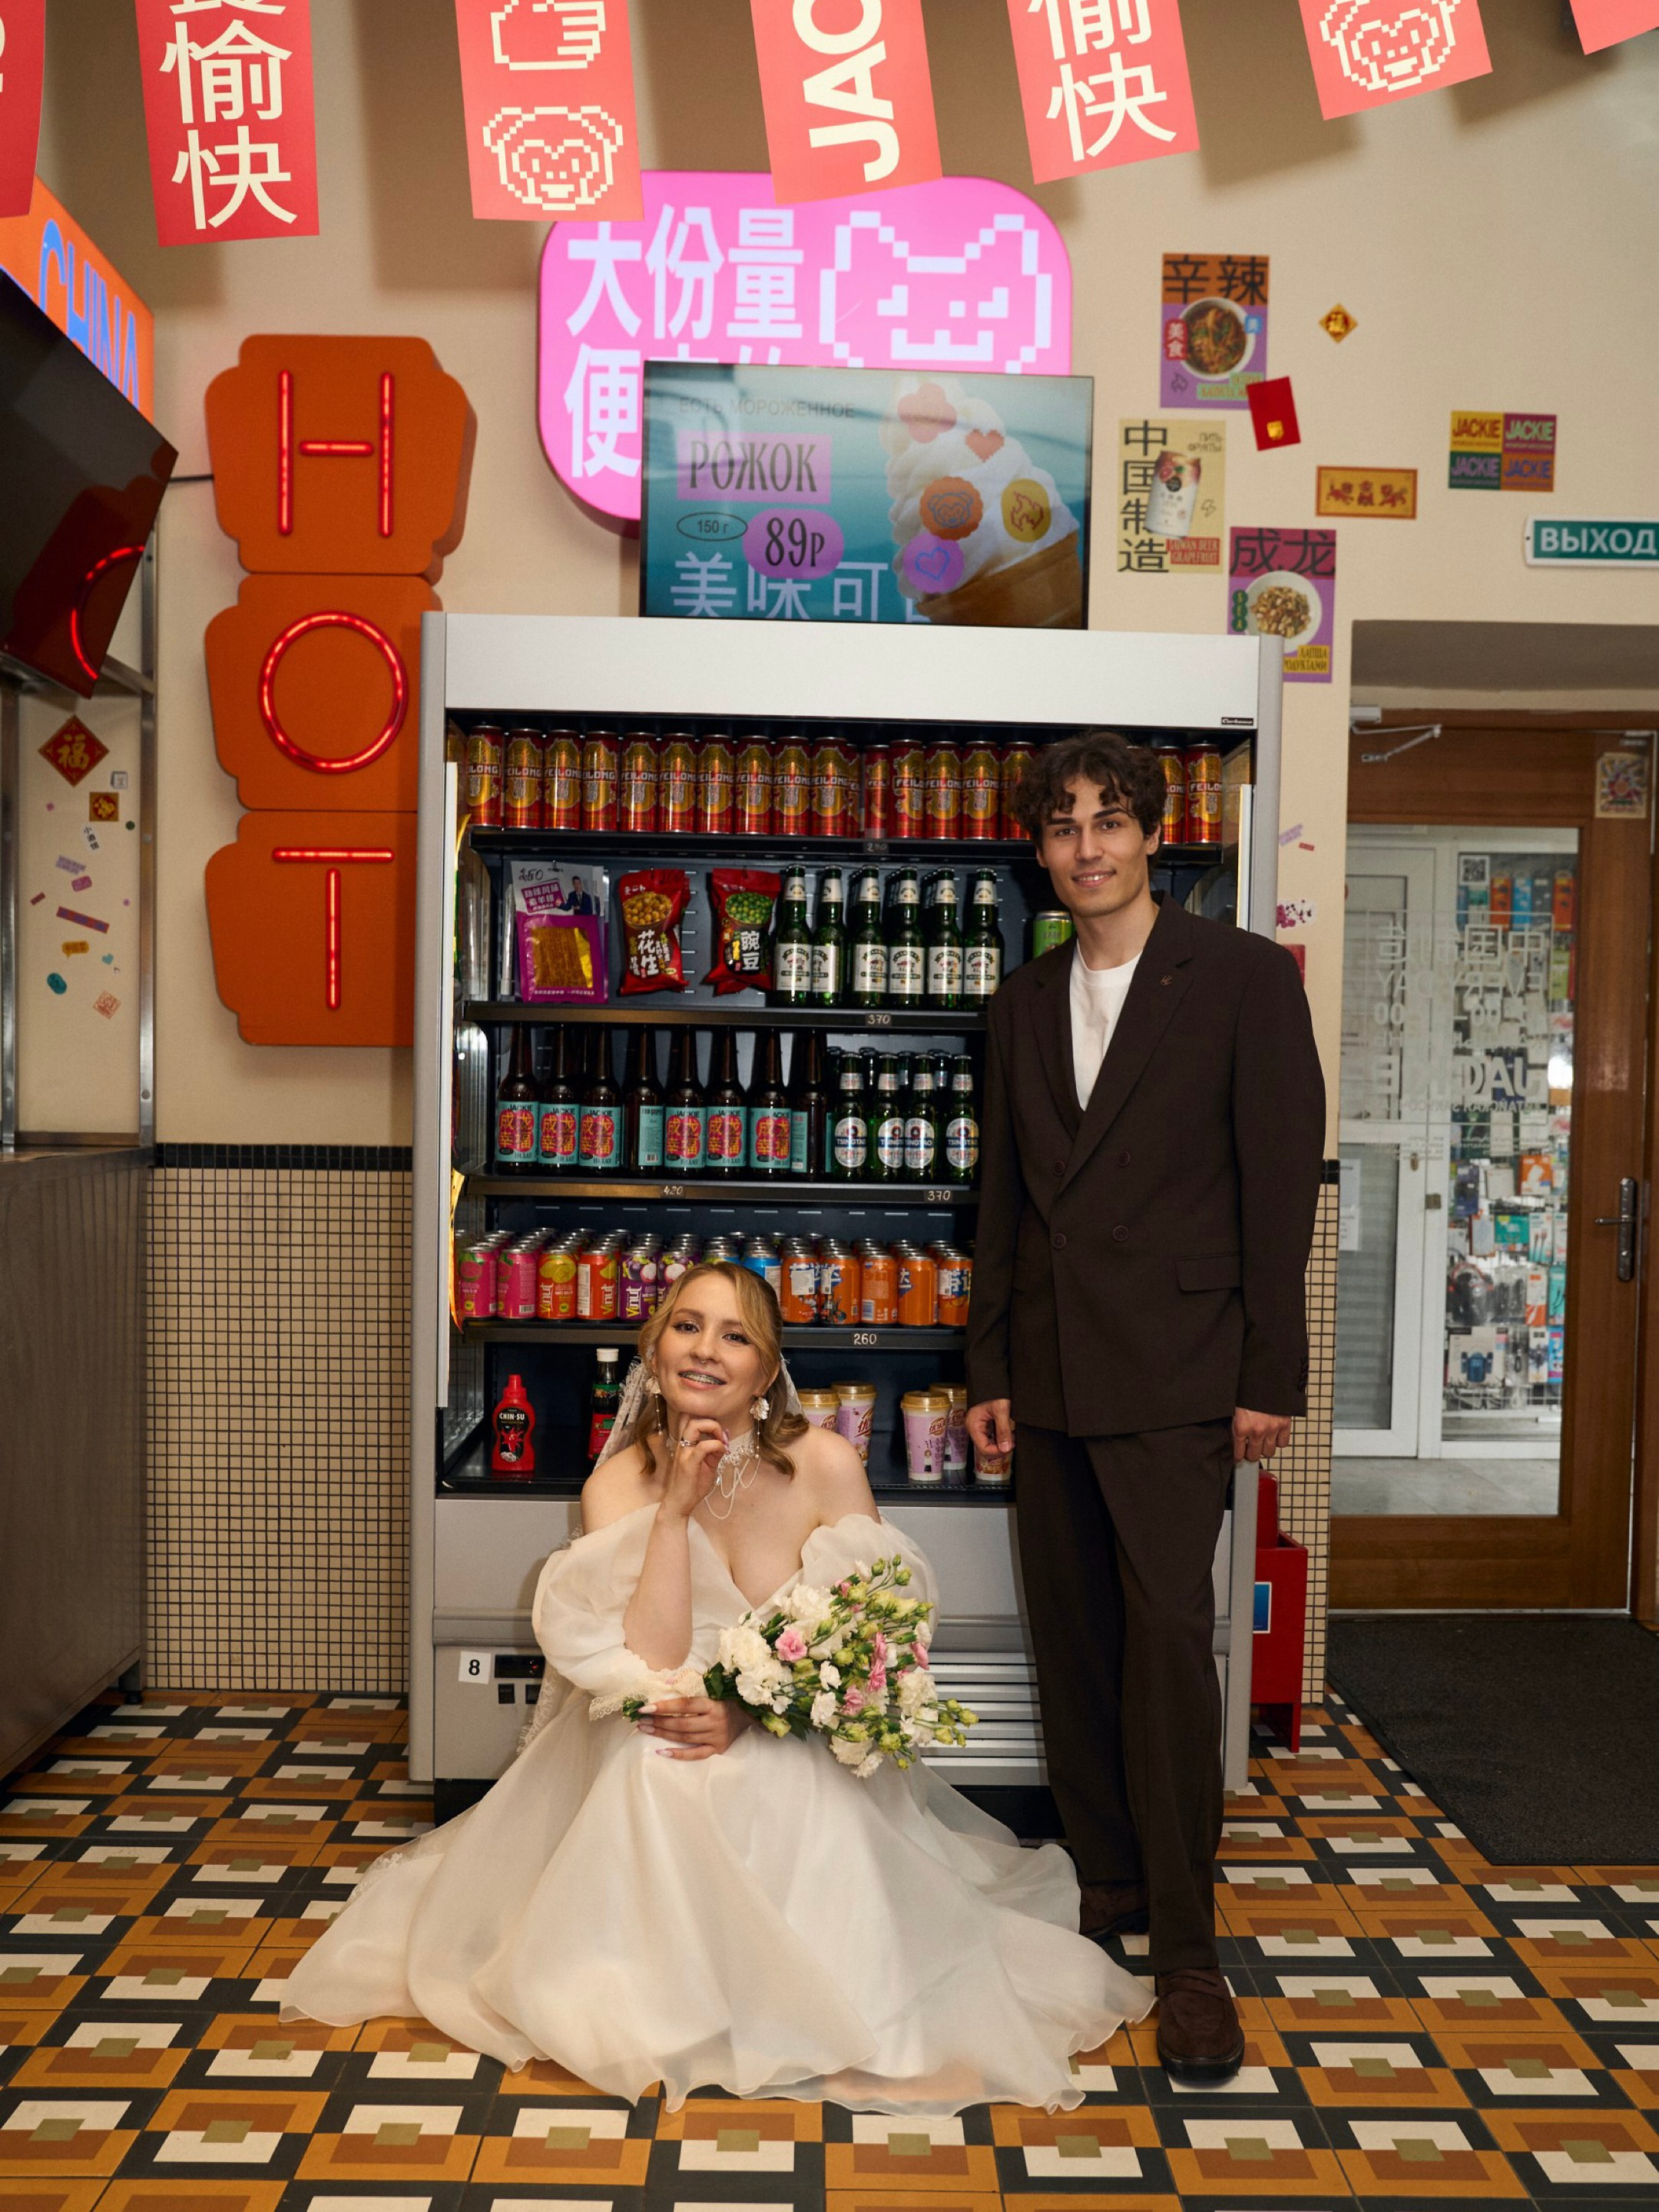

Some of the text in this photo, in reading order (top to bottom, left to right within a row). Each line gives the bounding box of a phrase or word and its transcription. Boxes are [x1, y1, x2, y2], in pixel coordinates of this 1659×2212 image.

[159, 0, 298, 230] 愉快
[566, 204, 803, 339] 大份量
[1163, 254, 1268, 306] 辛辣
[732, 399, 856, 418] МОРОЖЕННОЕ
[1453, 419, 1501, 438] JACKIE
[1505, 420, 1553, 441] JACKIE
[690, 440, 817, 493] РОЖОК
[1452, 456, 1499, 477] JACKIE
[1505, 459, 1551, 478] JACKIE
[697, 519, 720, 534] 150
[1541, 527, 1657, 555] ВЫХОД
[1230, 528, 1336, 576] 成龙
[259, 369, 408, 1012] HOT
[58, 733, 89, 770] 福
[637, 929, 659, 975] 花生
[867, 1014, 891, 1025] 370
[662, 1185, 683, 1195] 420
[927, 1190, 952, 1201] 370
[626, 1285, 642, 1317] Vnut
[853, 1333, 876, 1345] 260
[469, 1659, 481, 1676] 8
